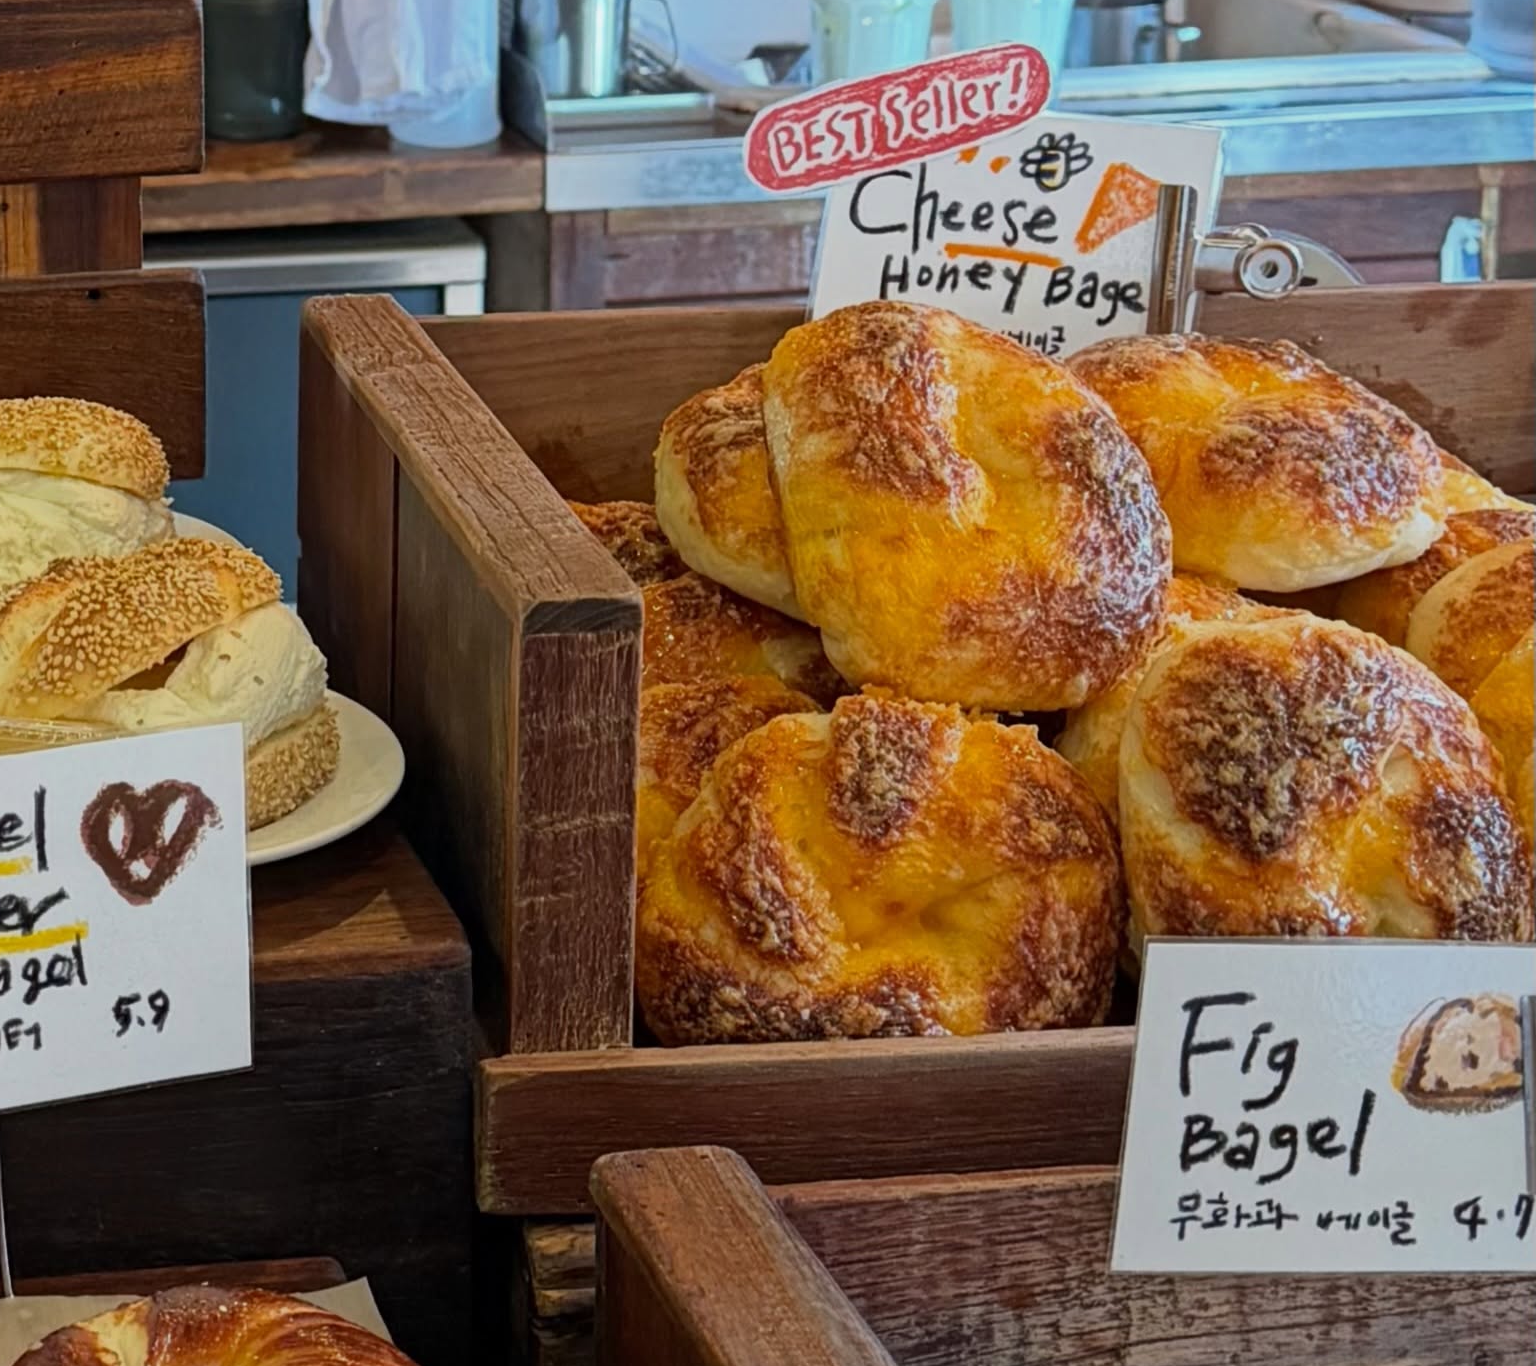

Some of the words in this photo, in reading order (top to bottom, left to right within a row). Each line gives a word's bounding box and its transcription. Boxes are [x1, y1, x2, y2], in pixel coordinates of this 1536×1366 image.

[770, 105, 875, 175] BEST
[879, 58, 1029, 146] Seller!
[849, 162, 1060, 253] Cheese
[879, 254, 1027, 314] Honey
[1044, 265, 1147, 326] Bage
[112, 989, 171, 1037] 5.9
[1179, 992, 1300, 1112] Fig
[1179, 1088, 1376, 1185] Bagel
[1170, 1192, 1300, 1241] 무화과
[1316, 1201, 1417, 1245] 베이글
